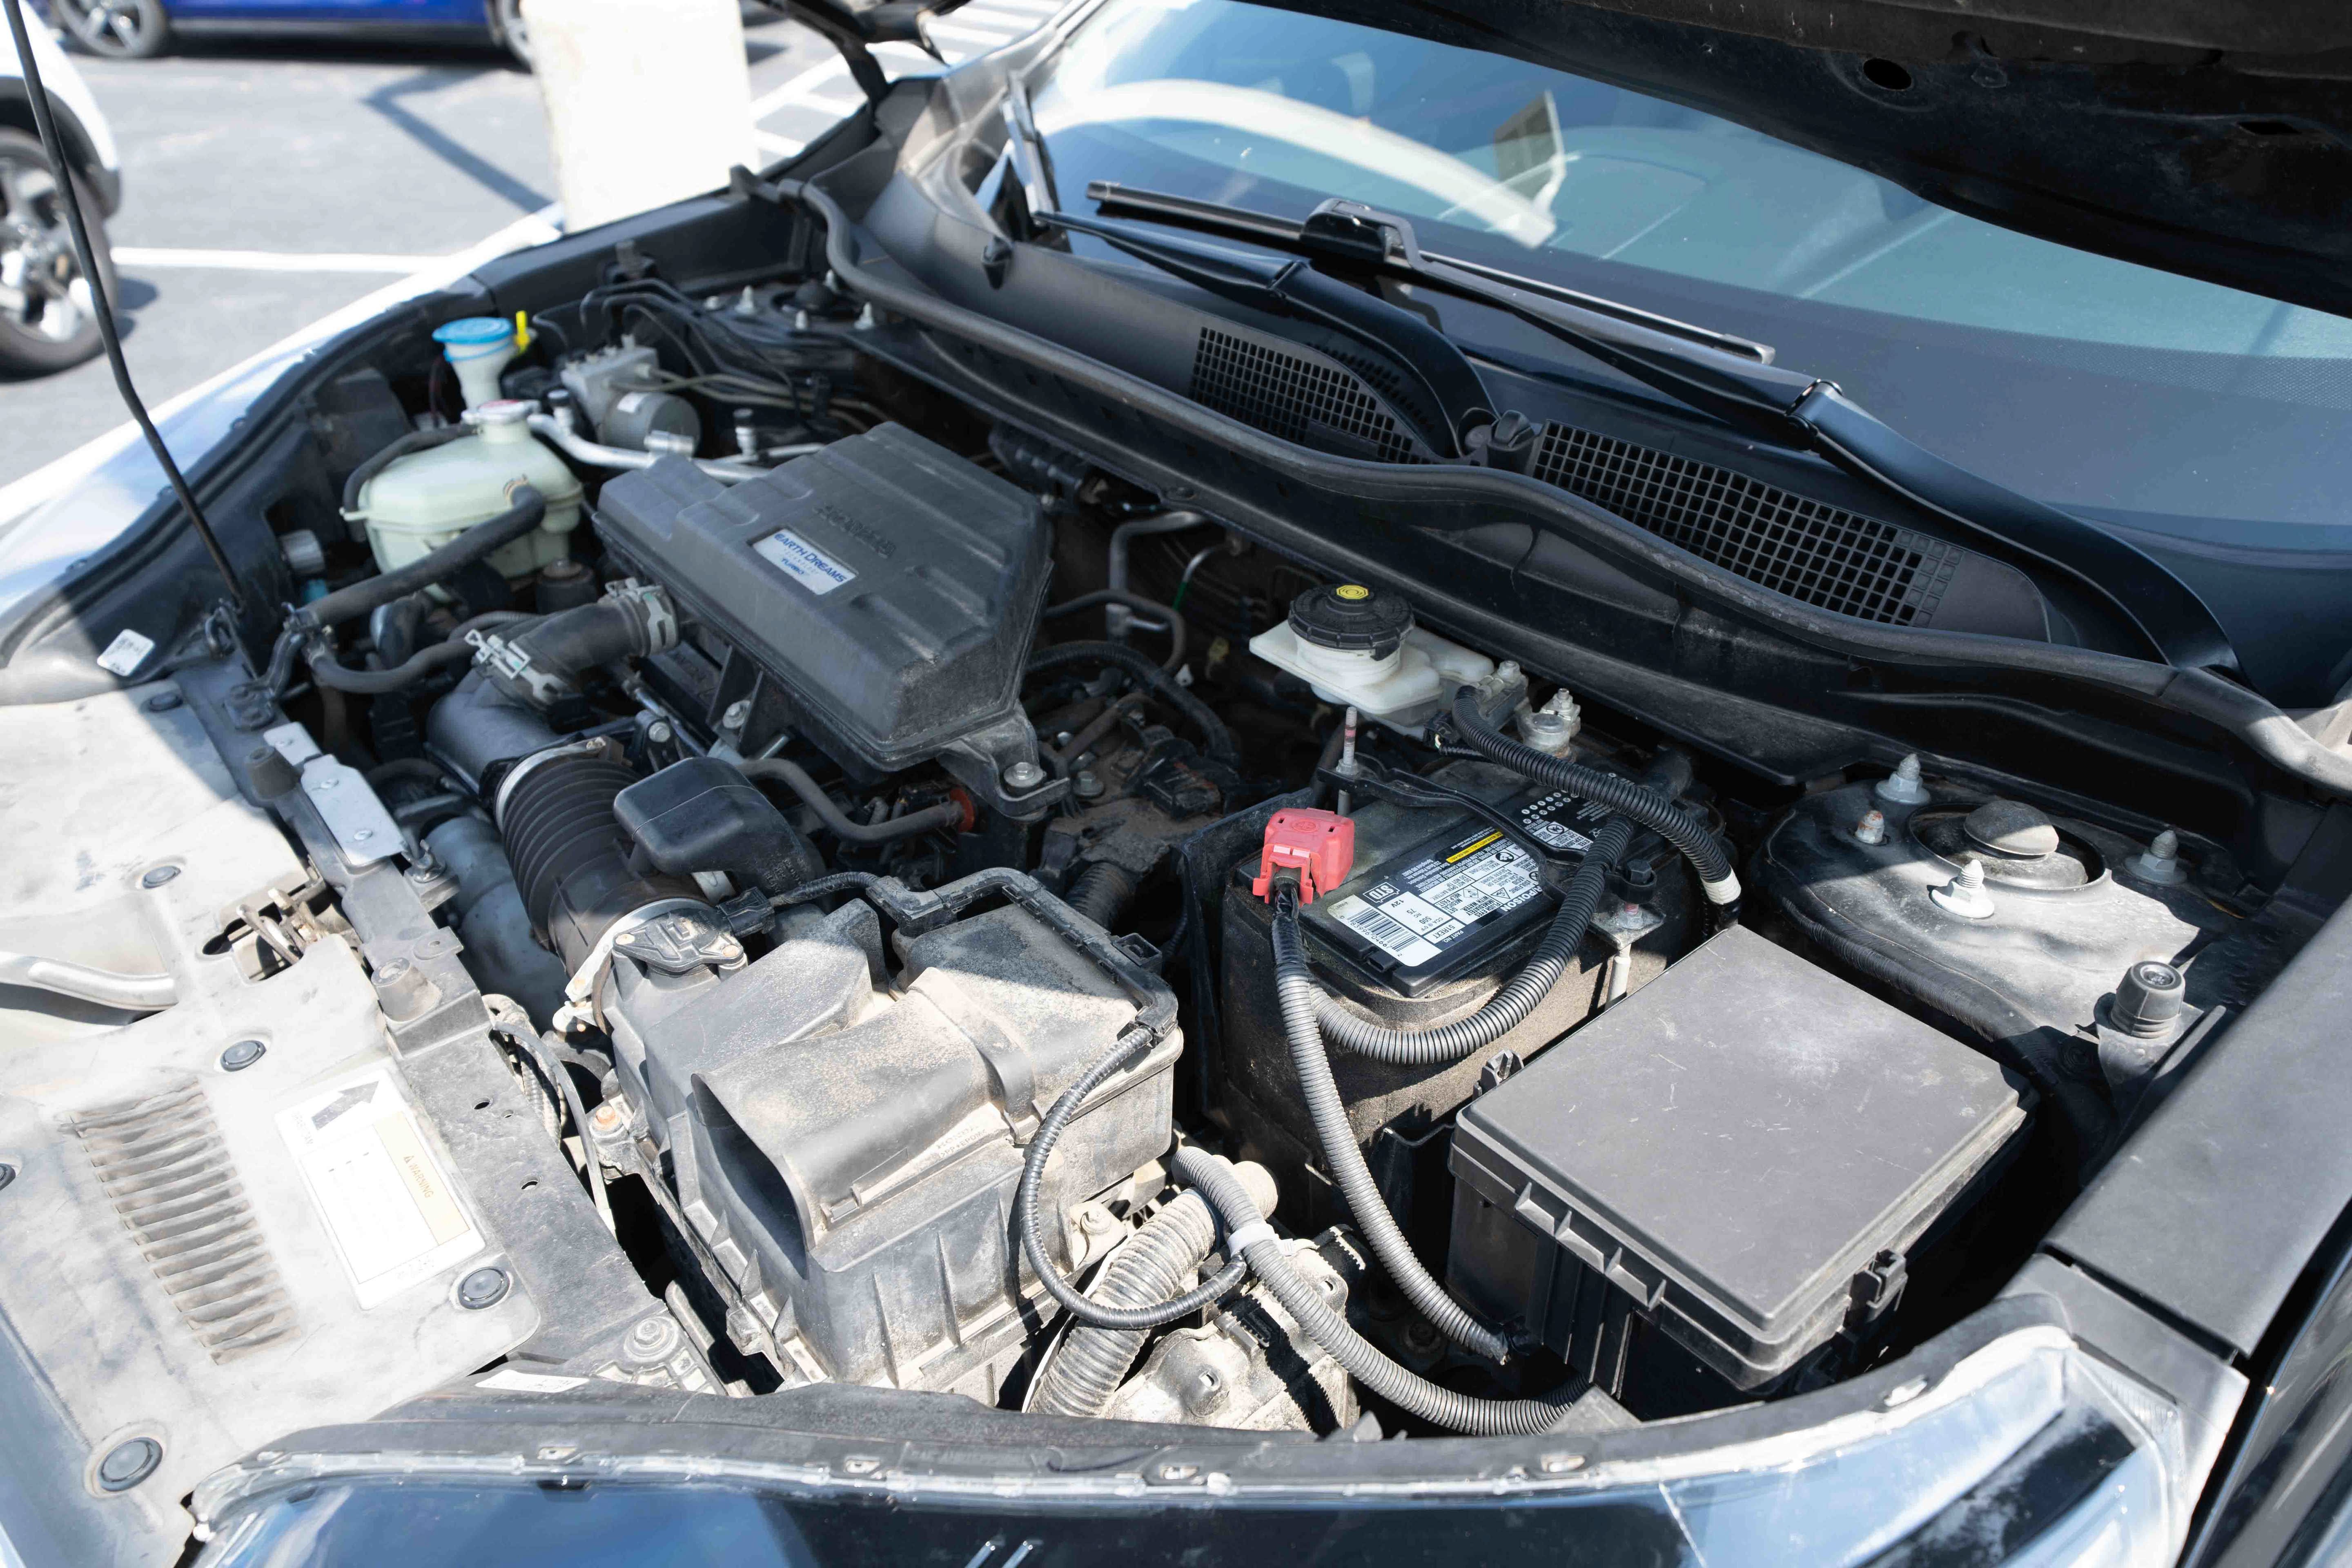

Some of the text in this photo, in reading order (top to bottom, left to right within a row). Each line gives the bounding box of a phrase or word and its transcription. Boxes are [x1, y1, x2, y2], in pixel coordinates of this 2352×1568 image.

[774, 533, 847, 582] EARTH DREAMS
[782, 558, 804, 575] TURBO
[1497, 878, 1510, 887] CAUSE
[1508, 880, 1530, 894] SULFURIC
[1367, 884, 1395, 901] STD
[1436, 892, 1461, 907] HELP FAST.
[1390, 898, 1405, 908] 12V
[1441, 898, 1463, 911] MEDICAL
[1459, 895, 1490, 912] WITH WATER.
[1465, 898, 1495, 916] IMMEDIATELY
[1474, 902, 1501, 917] FLUSH EYES
[1418, 916, 1432, 924] 500
[1350, 922, 1372, 935] 83996
[1370, 935, 1393, 949] 04667
[1431, 924, 1456, 939] 51REXT
[1450, 930, 1464, 938] PART
[408, 1163, 434, 1198] WARNING
